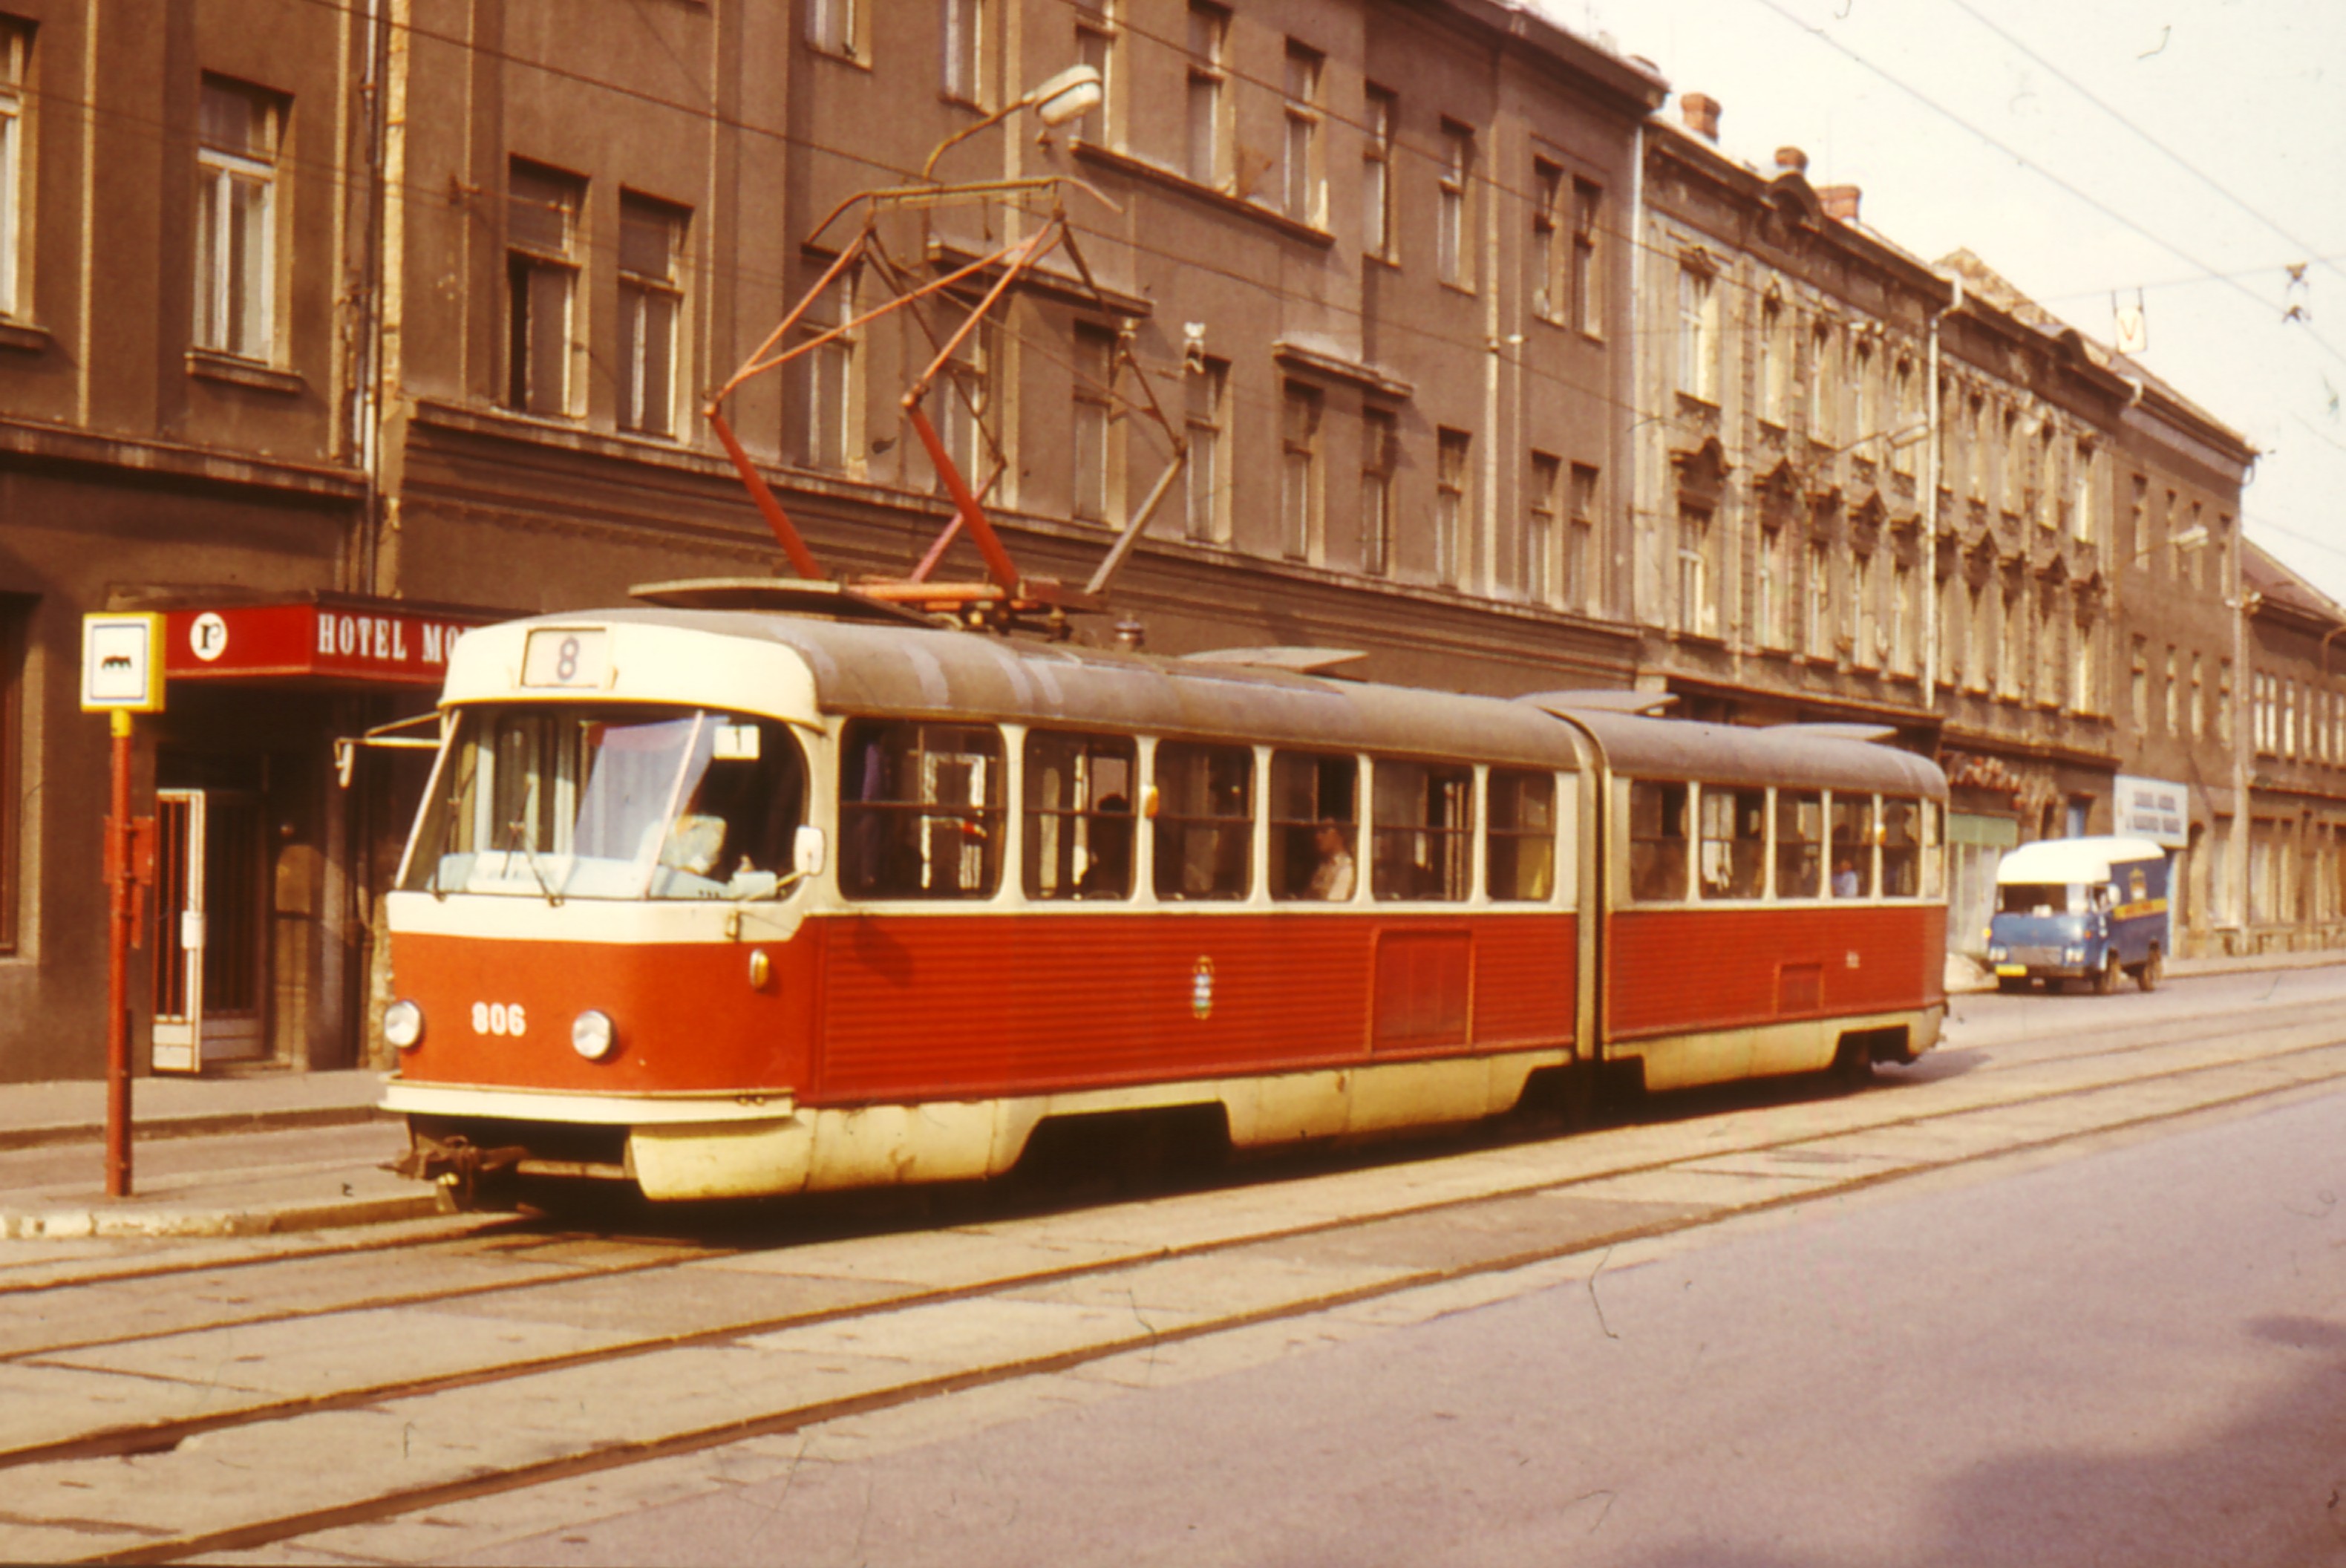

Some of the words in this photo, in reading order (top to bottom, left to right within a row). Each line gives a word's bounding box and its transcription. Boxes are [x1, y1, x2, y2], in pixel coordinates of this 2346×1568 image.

[318, 613, 407, 662] HOTEL
[422, 622, 479, 664] MO
[558, 636, 580, 681] 8
[471, 1001, 526, 1036] 806
